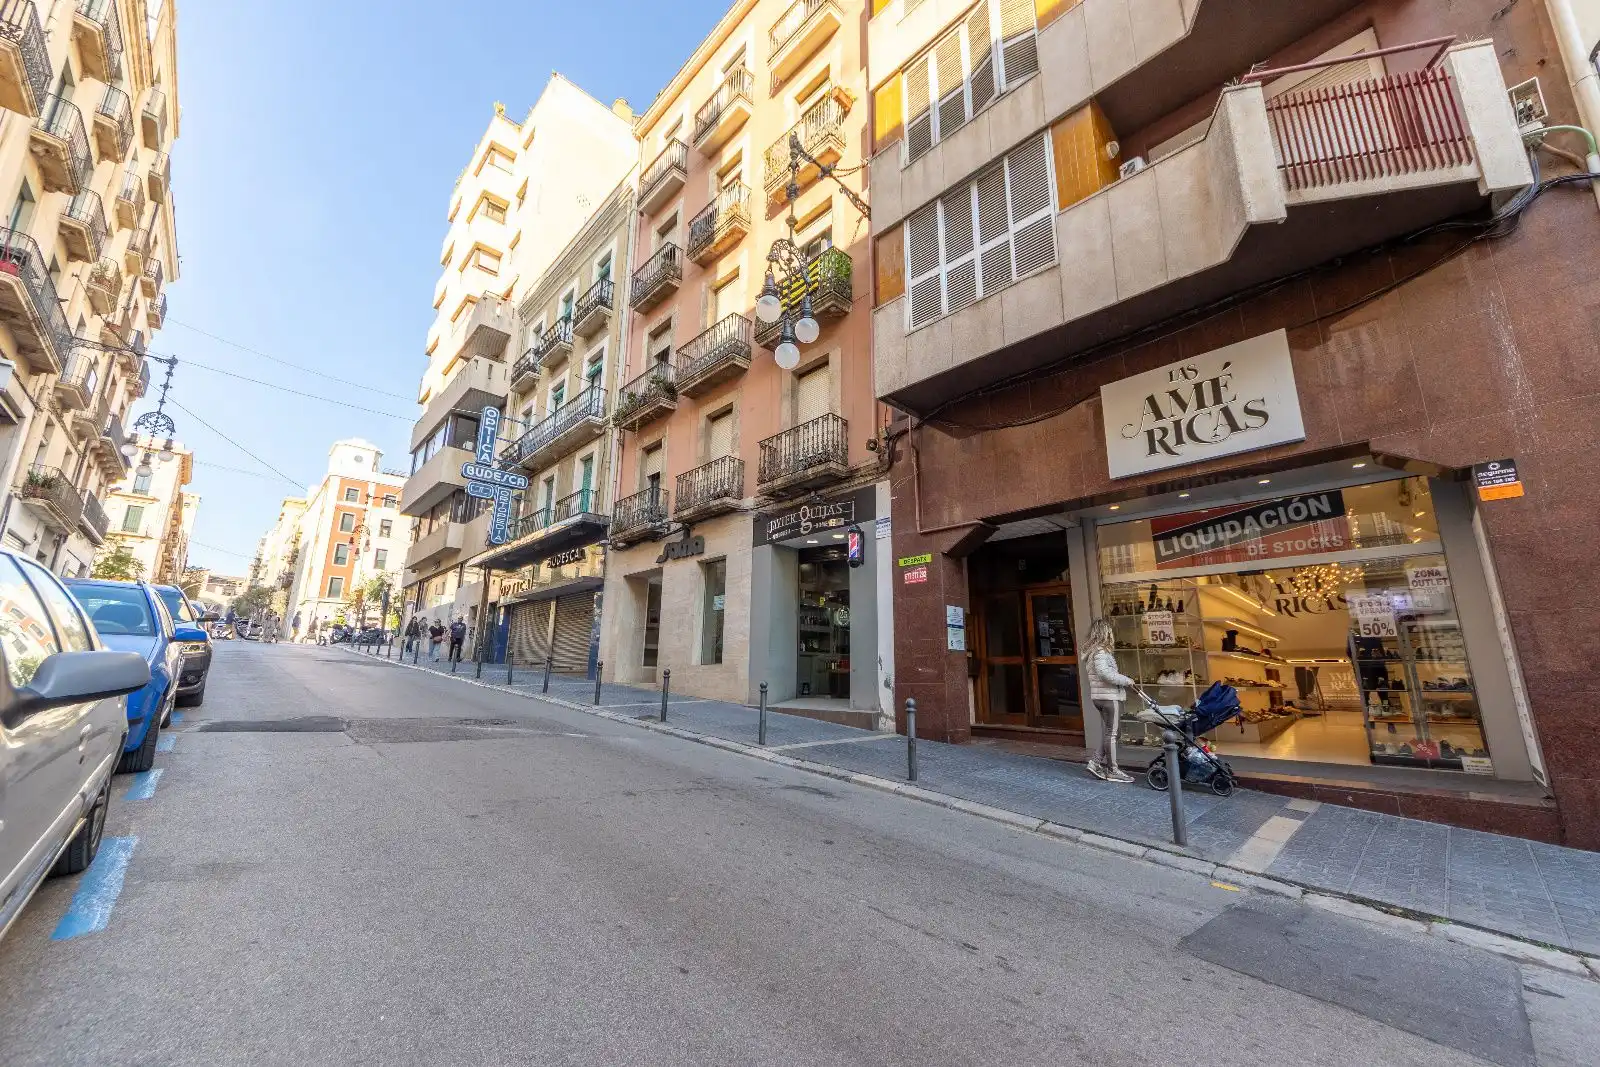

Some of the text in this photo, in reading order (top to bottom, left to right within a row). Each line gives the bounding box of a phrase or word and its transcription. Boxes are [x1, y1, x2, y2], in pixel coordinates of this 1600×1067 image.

[1168, 364, 1199, 383] LAS
[1121, 361, 1238, 438] AMÉ
[480, 409, 497, 463] OPTICA
[1144, 397, 1270, 457] RICAS
[466, 465, 525, 487] BUDESCA
[1158, 494, 1332, 557] LIQUIDACIÓN
[1248, 535, 1344, 557] DE STOCKS
[1412, 577, 1448, 587] OUTLET
[1414, 569, 1442, 578] ZONA
[1151, 630, 1173, 642] 50%
[1362, 622, 1394, 636] 50%
